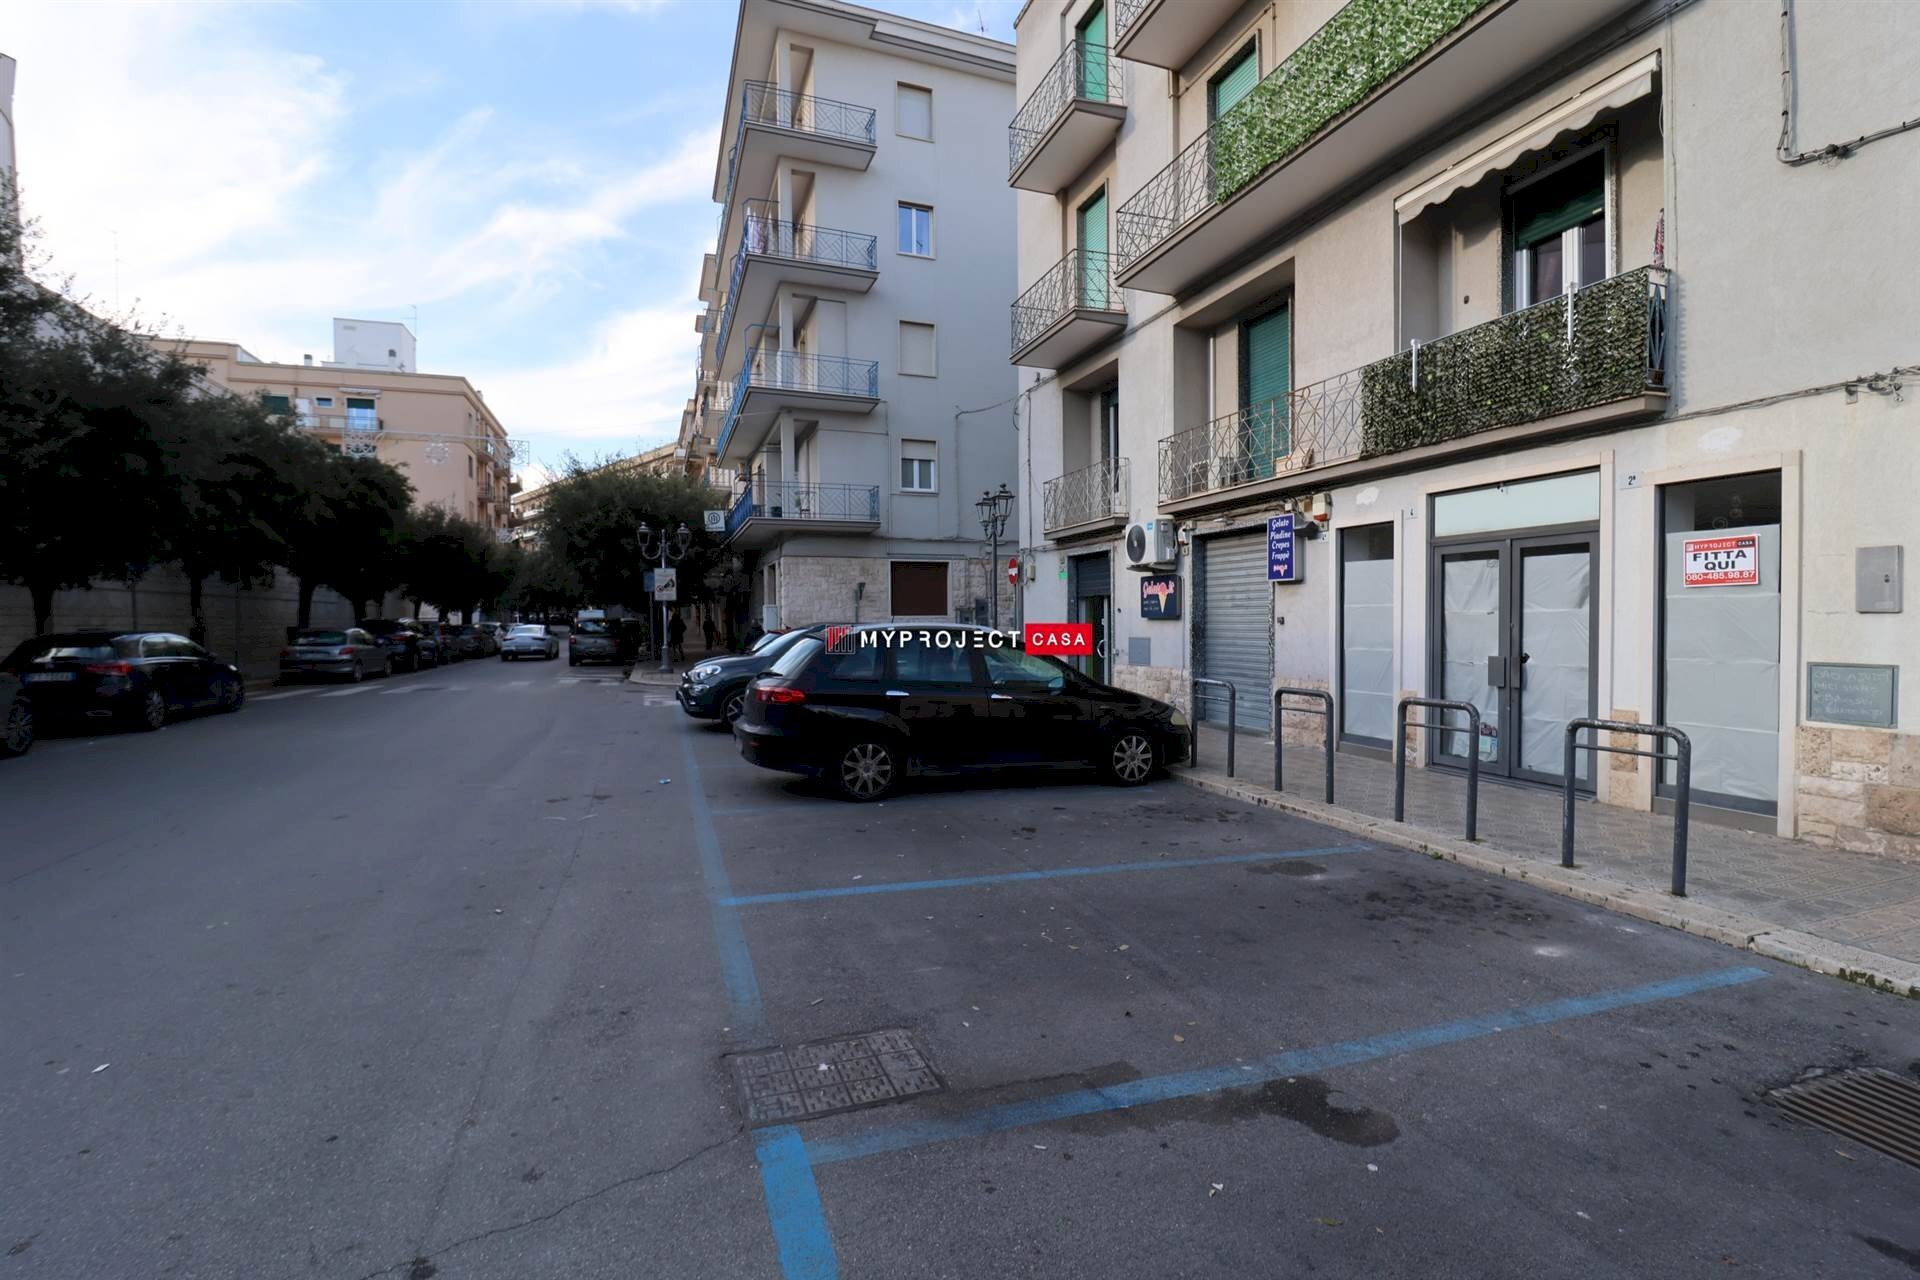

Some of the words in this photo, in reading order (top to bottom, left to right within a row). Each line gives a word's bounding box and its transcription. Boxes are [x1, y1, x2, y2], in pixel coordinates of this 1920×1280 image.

[1271, 540, 1290, 551] Crepes
[1693, 549, 1747, 562] FITTA
[1704, 560, 1736, 571] QUI
